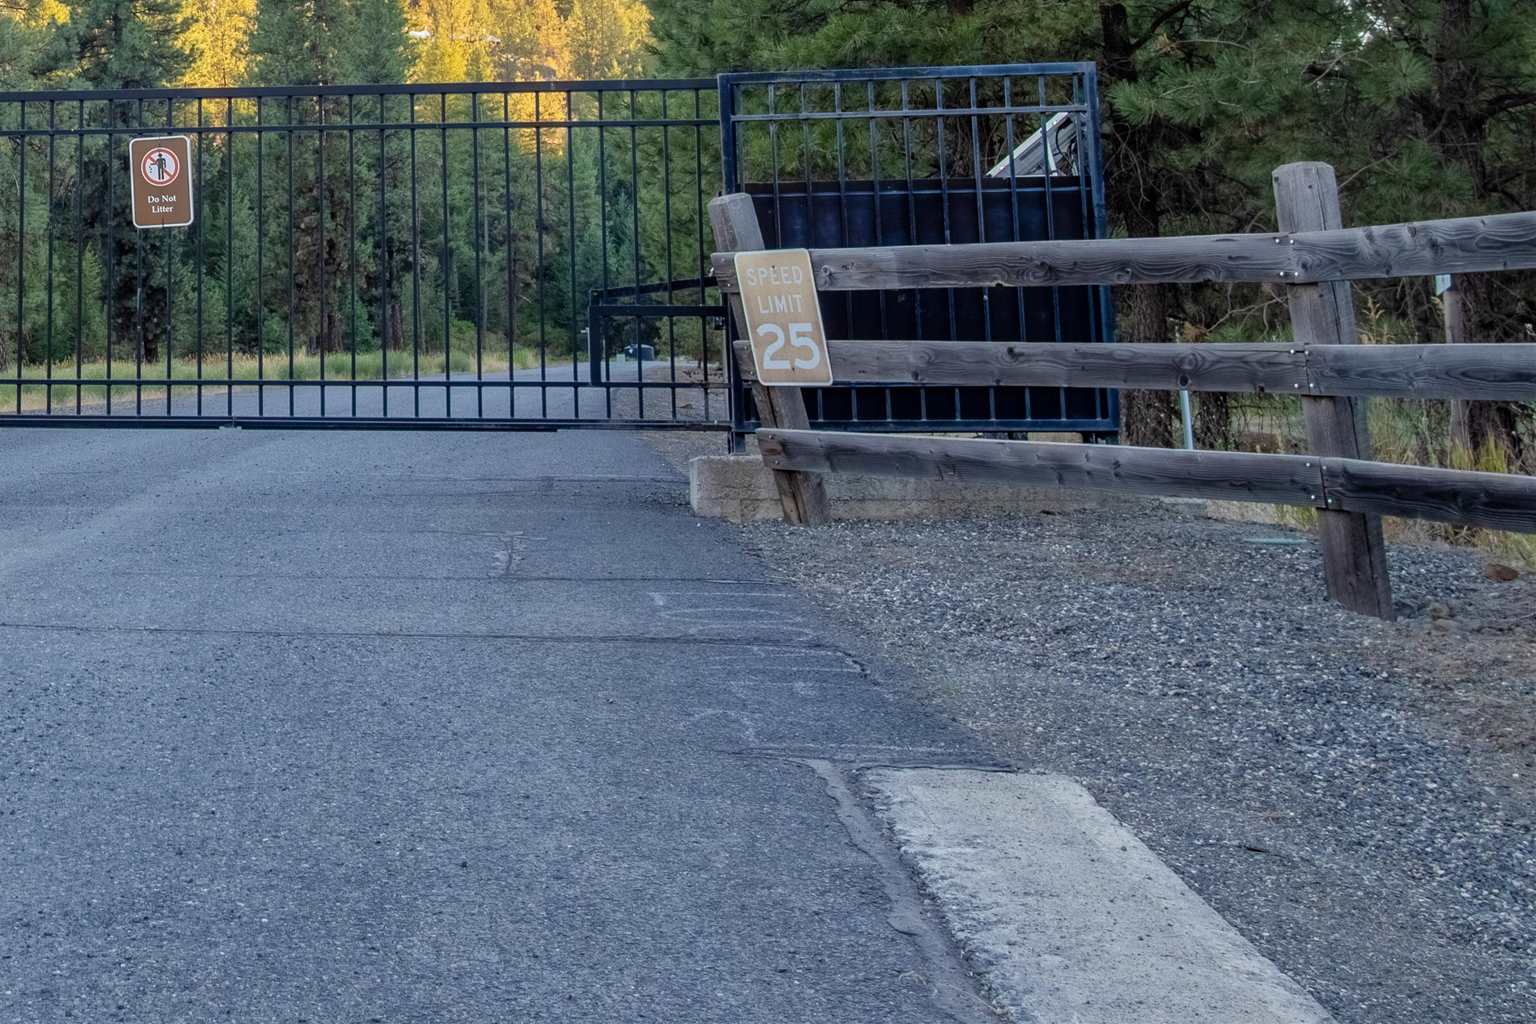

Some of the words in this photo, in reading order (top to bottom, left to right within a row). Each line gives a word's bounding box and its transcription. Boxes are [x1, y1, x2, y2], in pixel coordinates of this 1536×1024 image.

[147, 195, 160, 204] Do
[161, 194, 177, 203] Not
[151, 205, 174, 214] Litter
[747, 265, 803, 286] SPEED
[757, 294, 803, 314] LIMIT
[756, 322, 820, 370] 25
